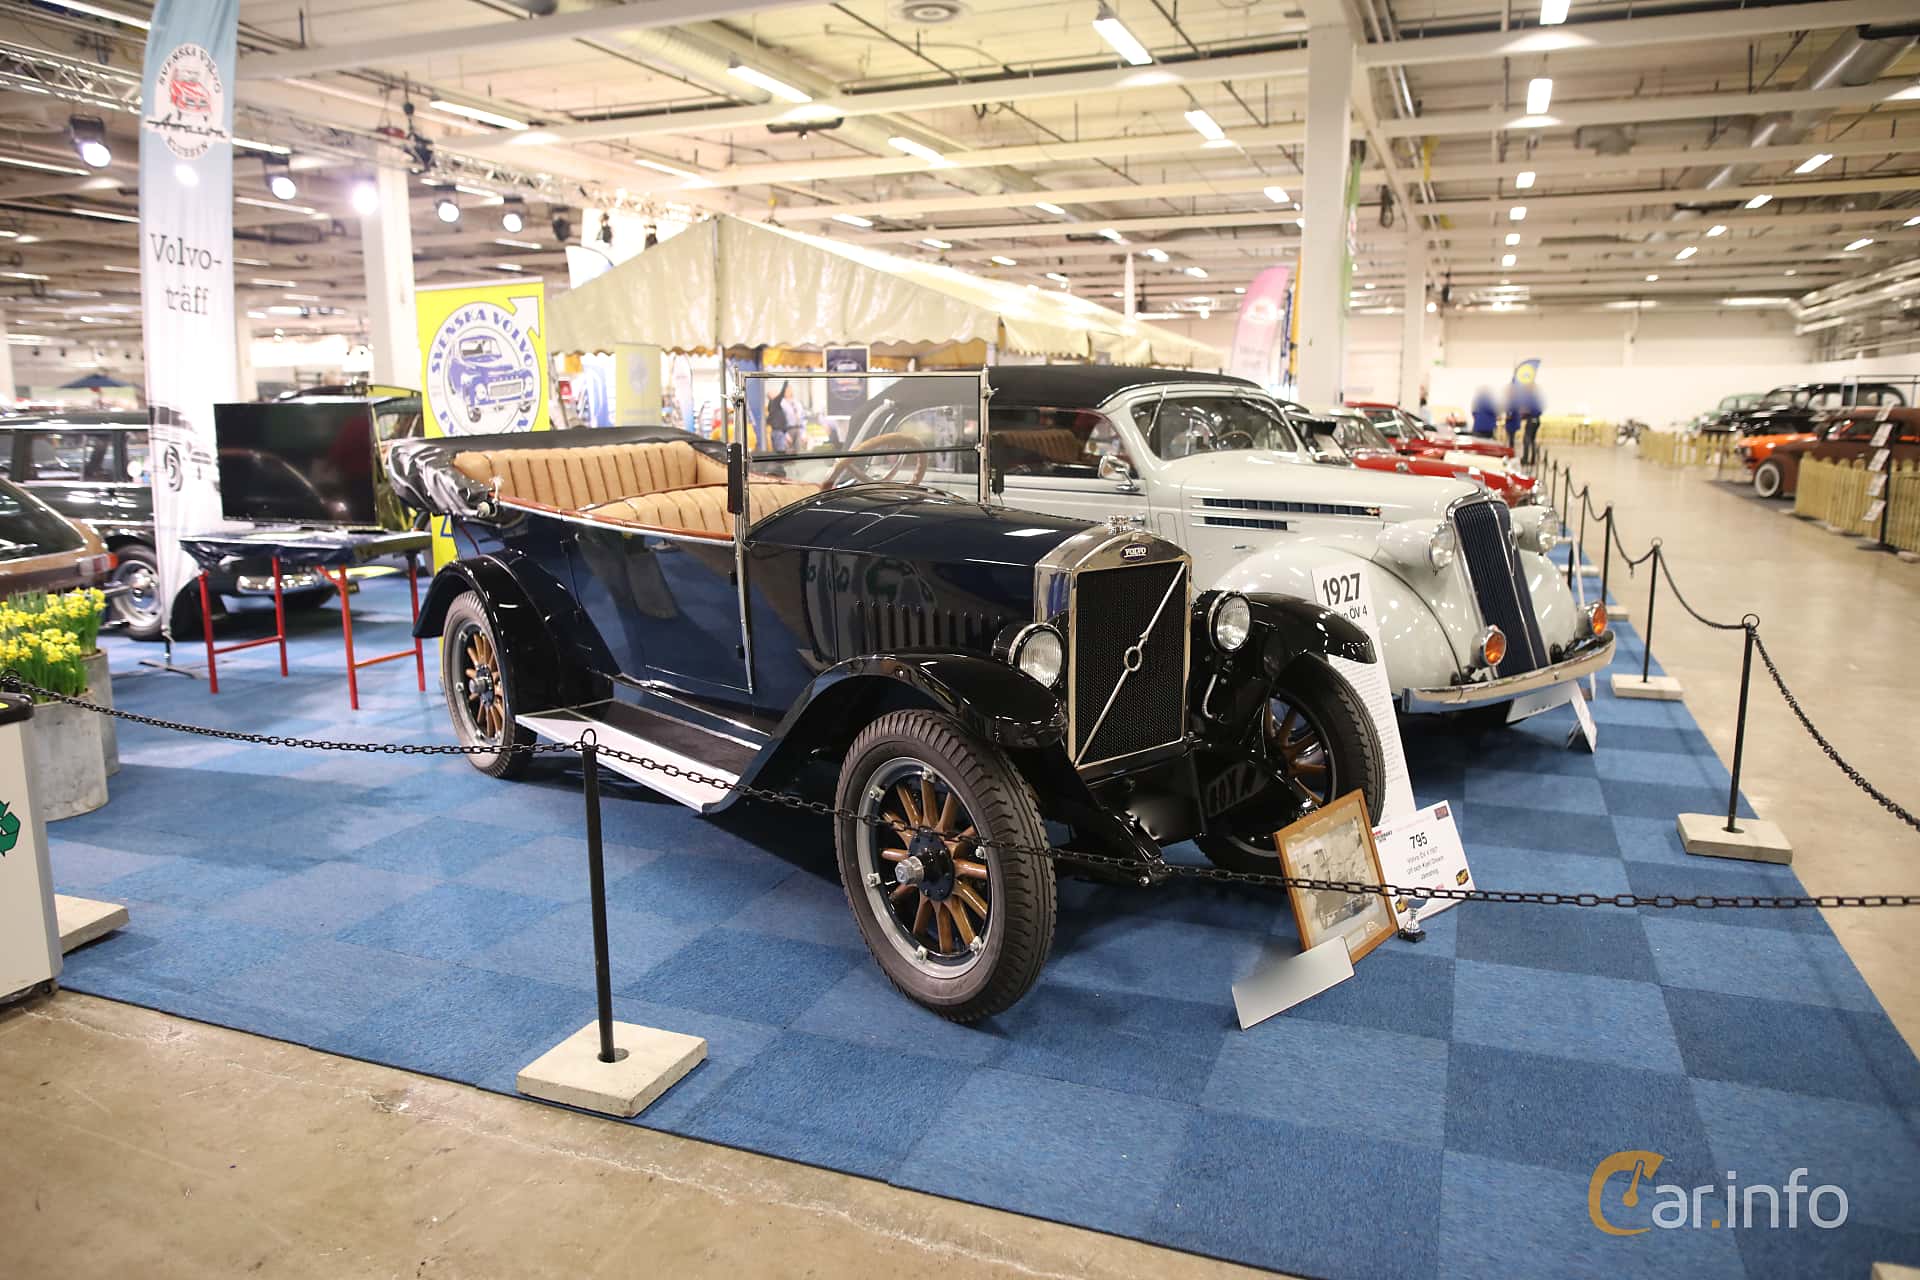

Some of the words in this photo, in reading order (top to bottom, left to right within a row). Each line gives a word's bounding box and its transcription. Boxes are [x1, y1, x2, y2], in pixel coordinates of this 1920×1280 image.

[150, 233, 223, 270] Volvo-
[165, 284, 209, 316] träff
[431, 309, 487, 373] SVENSKA
[493, 311, 535, 368] VOLVO
[1124, 547, 1147, 557] VOLVO
[1322, 572, 1361, 606] 1927
[1349, 605, 1360, 619] ÖV
[1362, 604, 1368, 616] 4
[1409, 832, 1428, 849] 795
